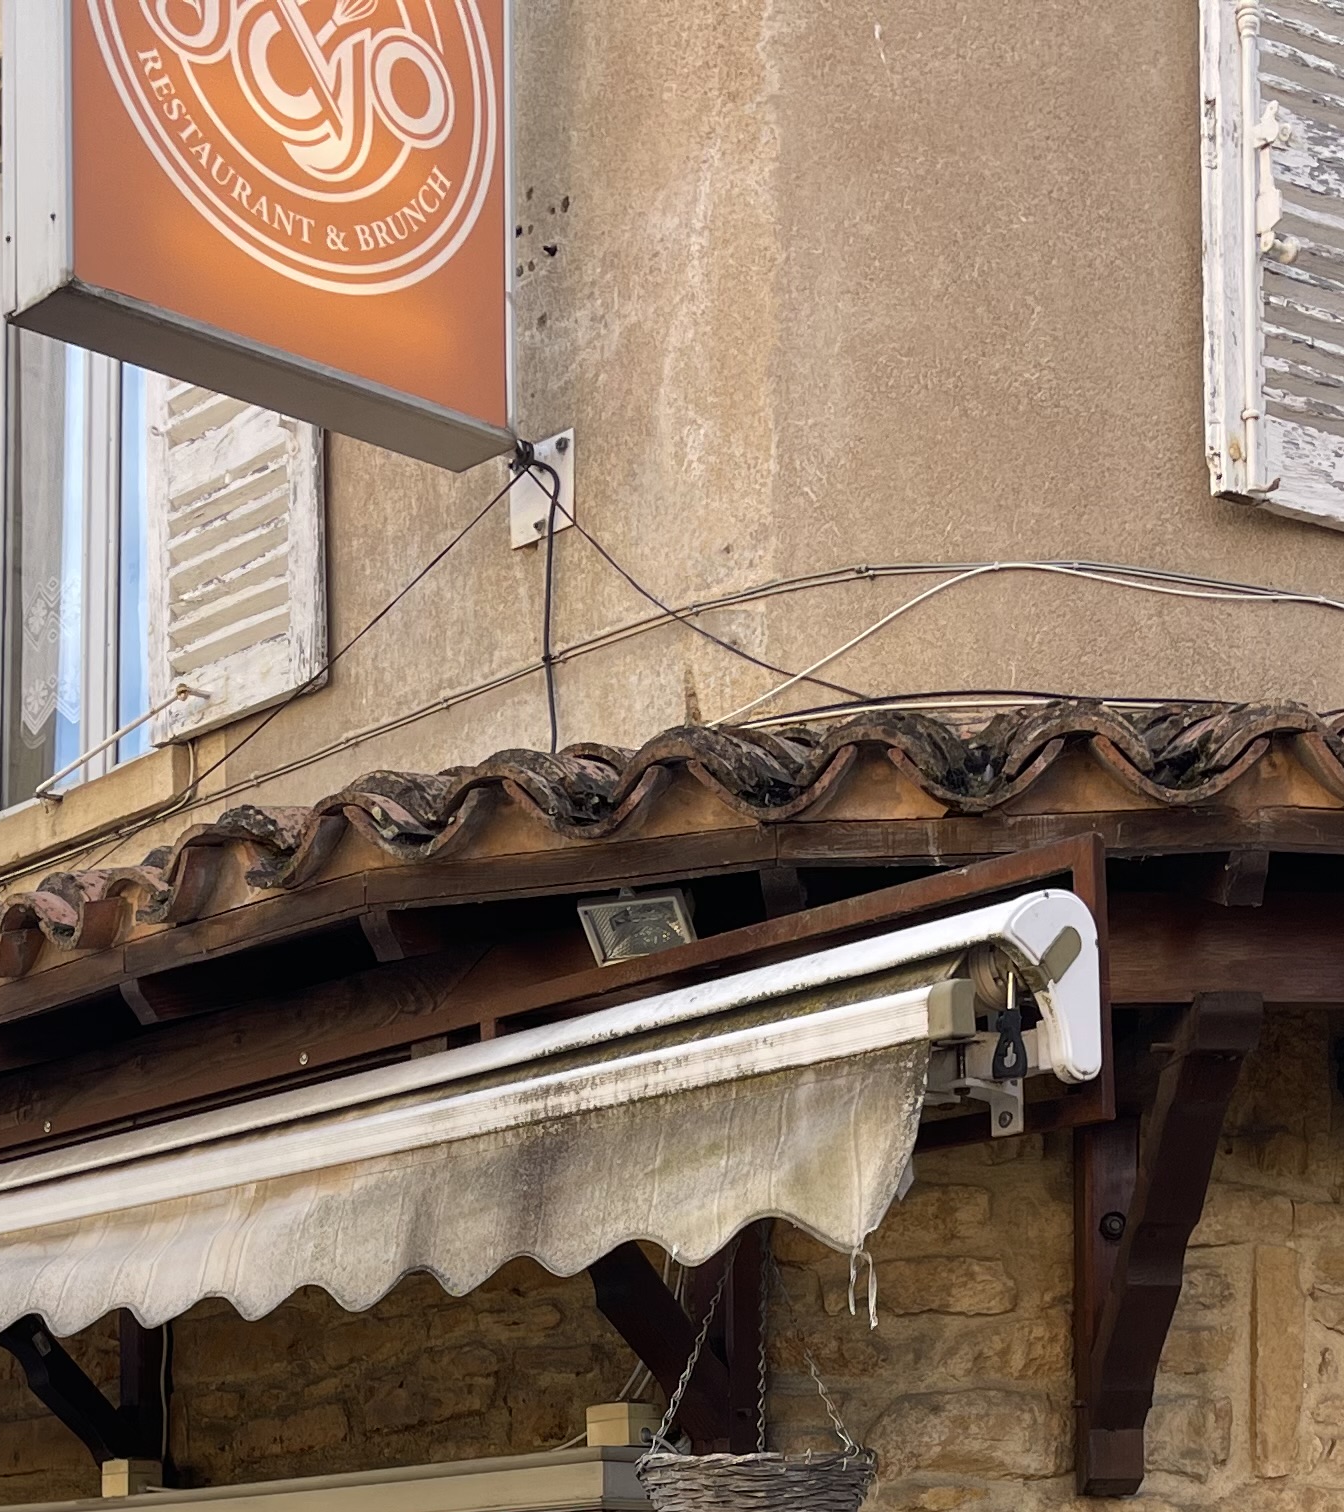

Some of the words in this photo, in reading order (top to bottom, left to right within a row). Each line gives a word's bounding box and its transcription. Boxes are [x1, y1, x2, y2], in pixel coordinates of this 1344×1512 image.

[137, 46, 315, 245] RESTAURANT
[325, 224, 350, 252] &
[355, 164, 452, 253] BRUNCH
